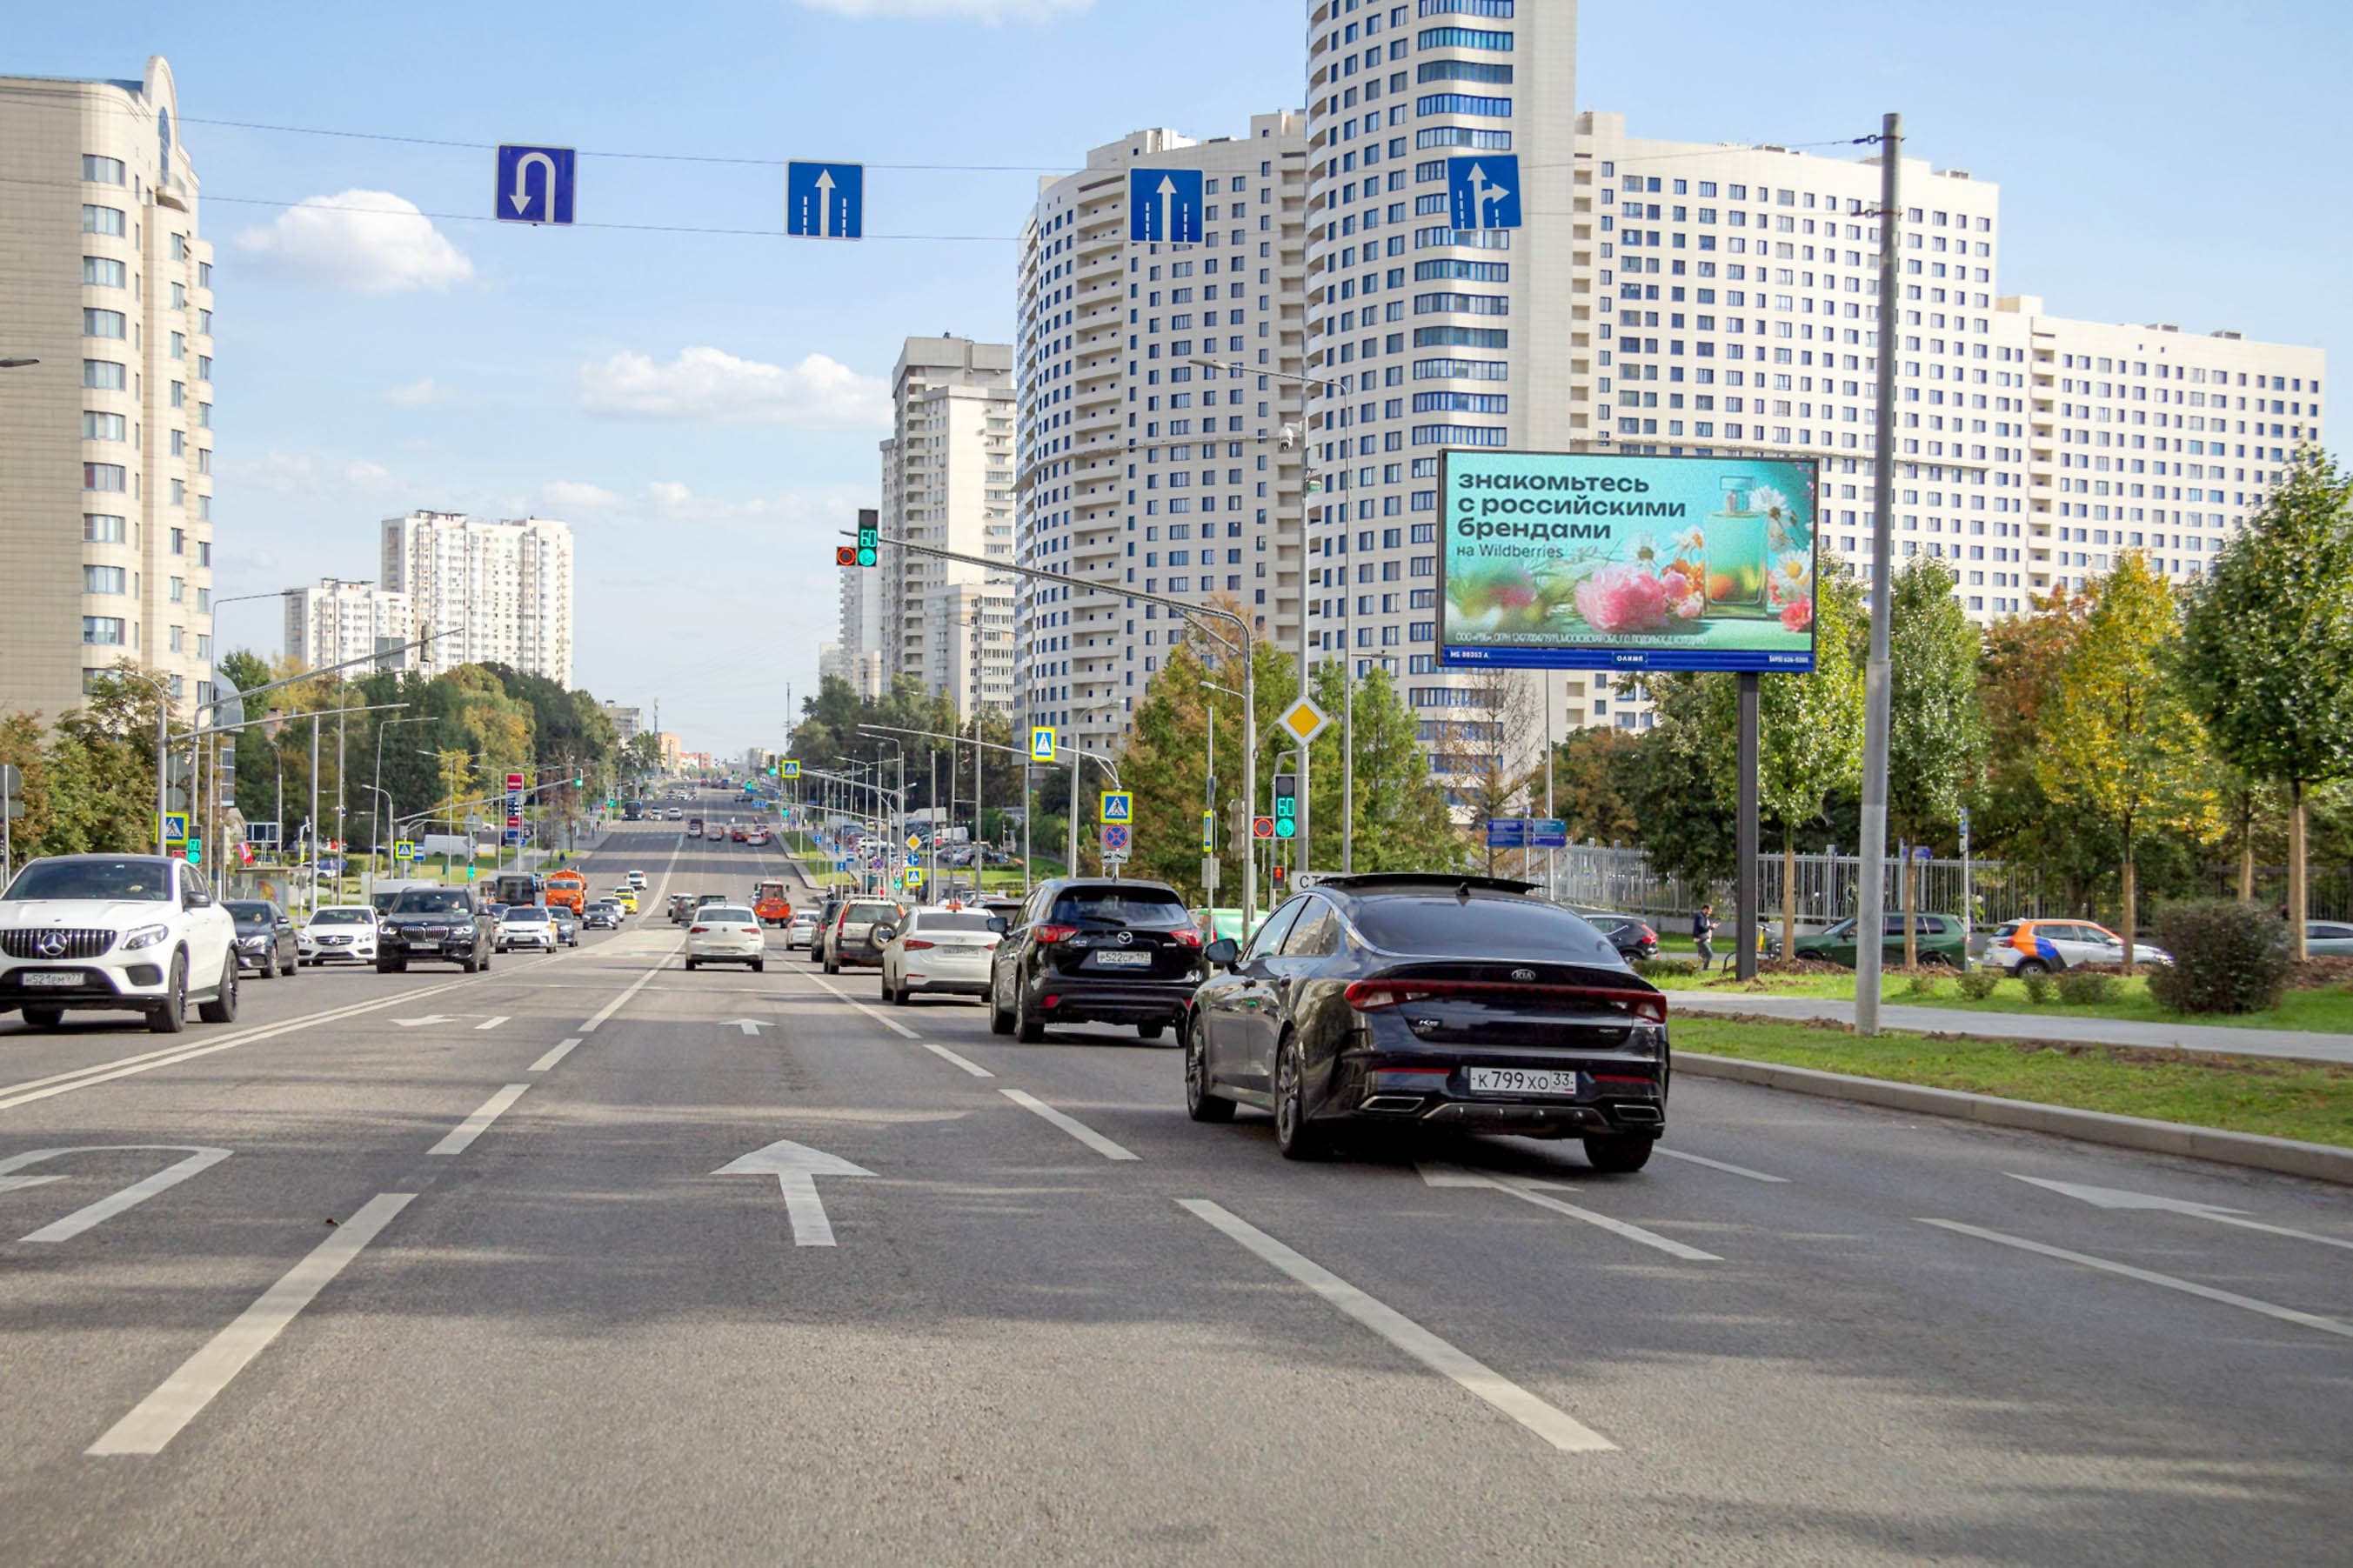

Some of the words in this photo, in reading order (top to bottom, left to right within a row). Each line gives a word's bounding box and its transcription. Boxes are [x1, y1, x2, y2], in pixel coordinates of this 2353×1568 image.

[1458, 473, 1649, 493] знакомьтесь
[1458, 497, 1475, 513] с
[1481, 494, 1686, 517] российскими
[859, 529, 878, 548] 60
[1457, 517, 1611, 541] брендами
[1456, 545, 1474, 557] на
[1479, 544, 1564, 558] Wildberries
[1277, 797, 1295, 817] 60
[1299, 875, 1331, 889] СТ
[1553, 1071, 1570, 1086] 33
